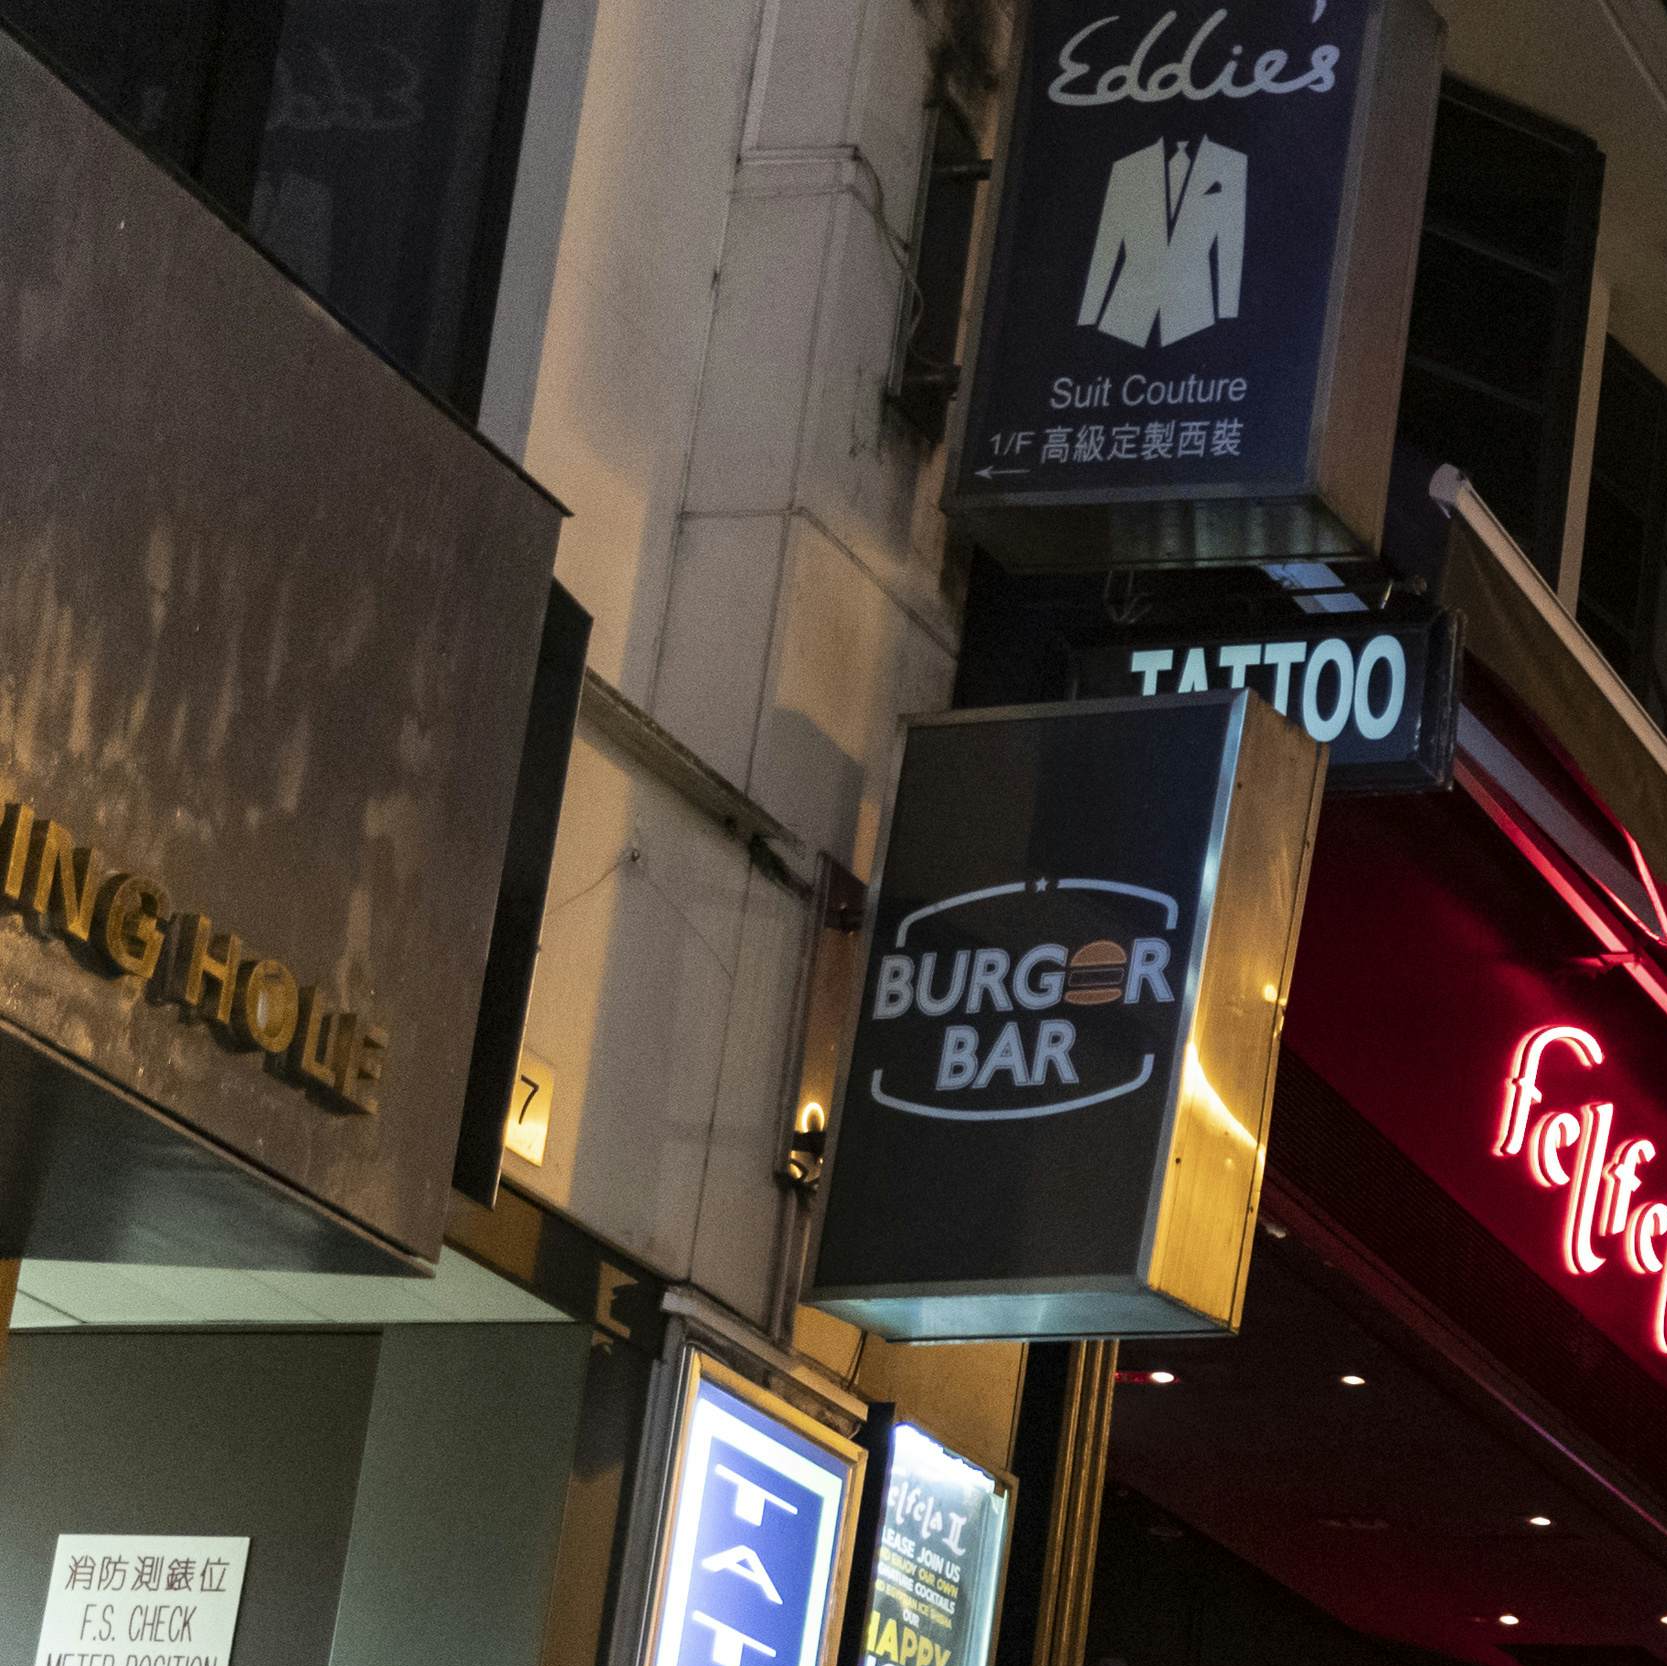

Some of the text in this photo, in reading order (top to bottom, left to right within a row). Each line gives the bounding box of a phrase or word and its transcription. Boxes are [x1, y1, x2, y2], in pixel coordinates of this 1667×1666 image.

[1050, 373, 1248, 409] Suit Couture
[989, 419, 1244, 464] 1/F 高級定製西裝
[935, 1018, 1080, 1091] BAR
[65, 1555, 230, 1593] 消防測錶位
[882, 1527, 961, 1583] LEASE JOIN US
[80, 1604, 197, 1642] F.S. CHECK
[902, 1609, 920, 1628] OUR
